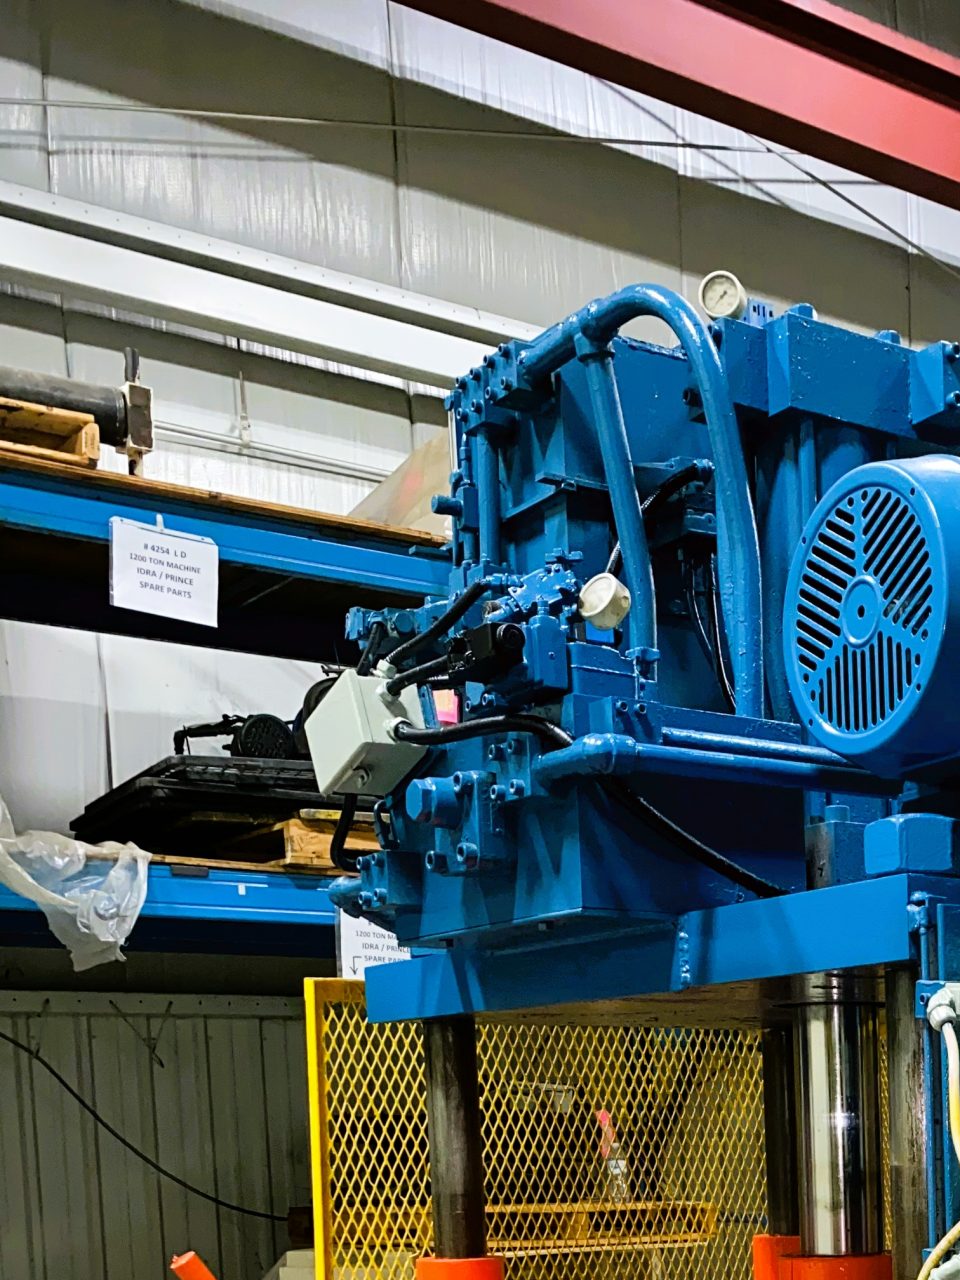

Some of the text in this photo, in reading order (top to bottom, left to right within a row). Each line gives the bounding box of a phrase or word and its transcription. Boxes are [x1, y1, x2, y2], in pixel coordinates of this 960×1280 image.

[150, 544, 170, 555] 4254
[129, 552, 201, 574] 1200 TON MACHINE
[136, 567, 157, 577] IDRA
[165, 573, 194, 586] PRINCE
[139, 581, 192, 599] SPARE PARTS
[356, 930, 371, 938] 1200
[372, 932, 386, 940] TON
[362, 942, 379, 950] IDRA
[364, 955, 386, 963] SPARE
